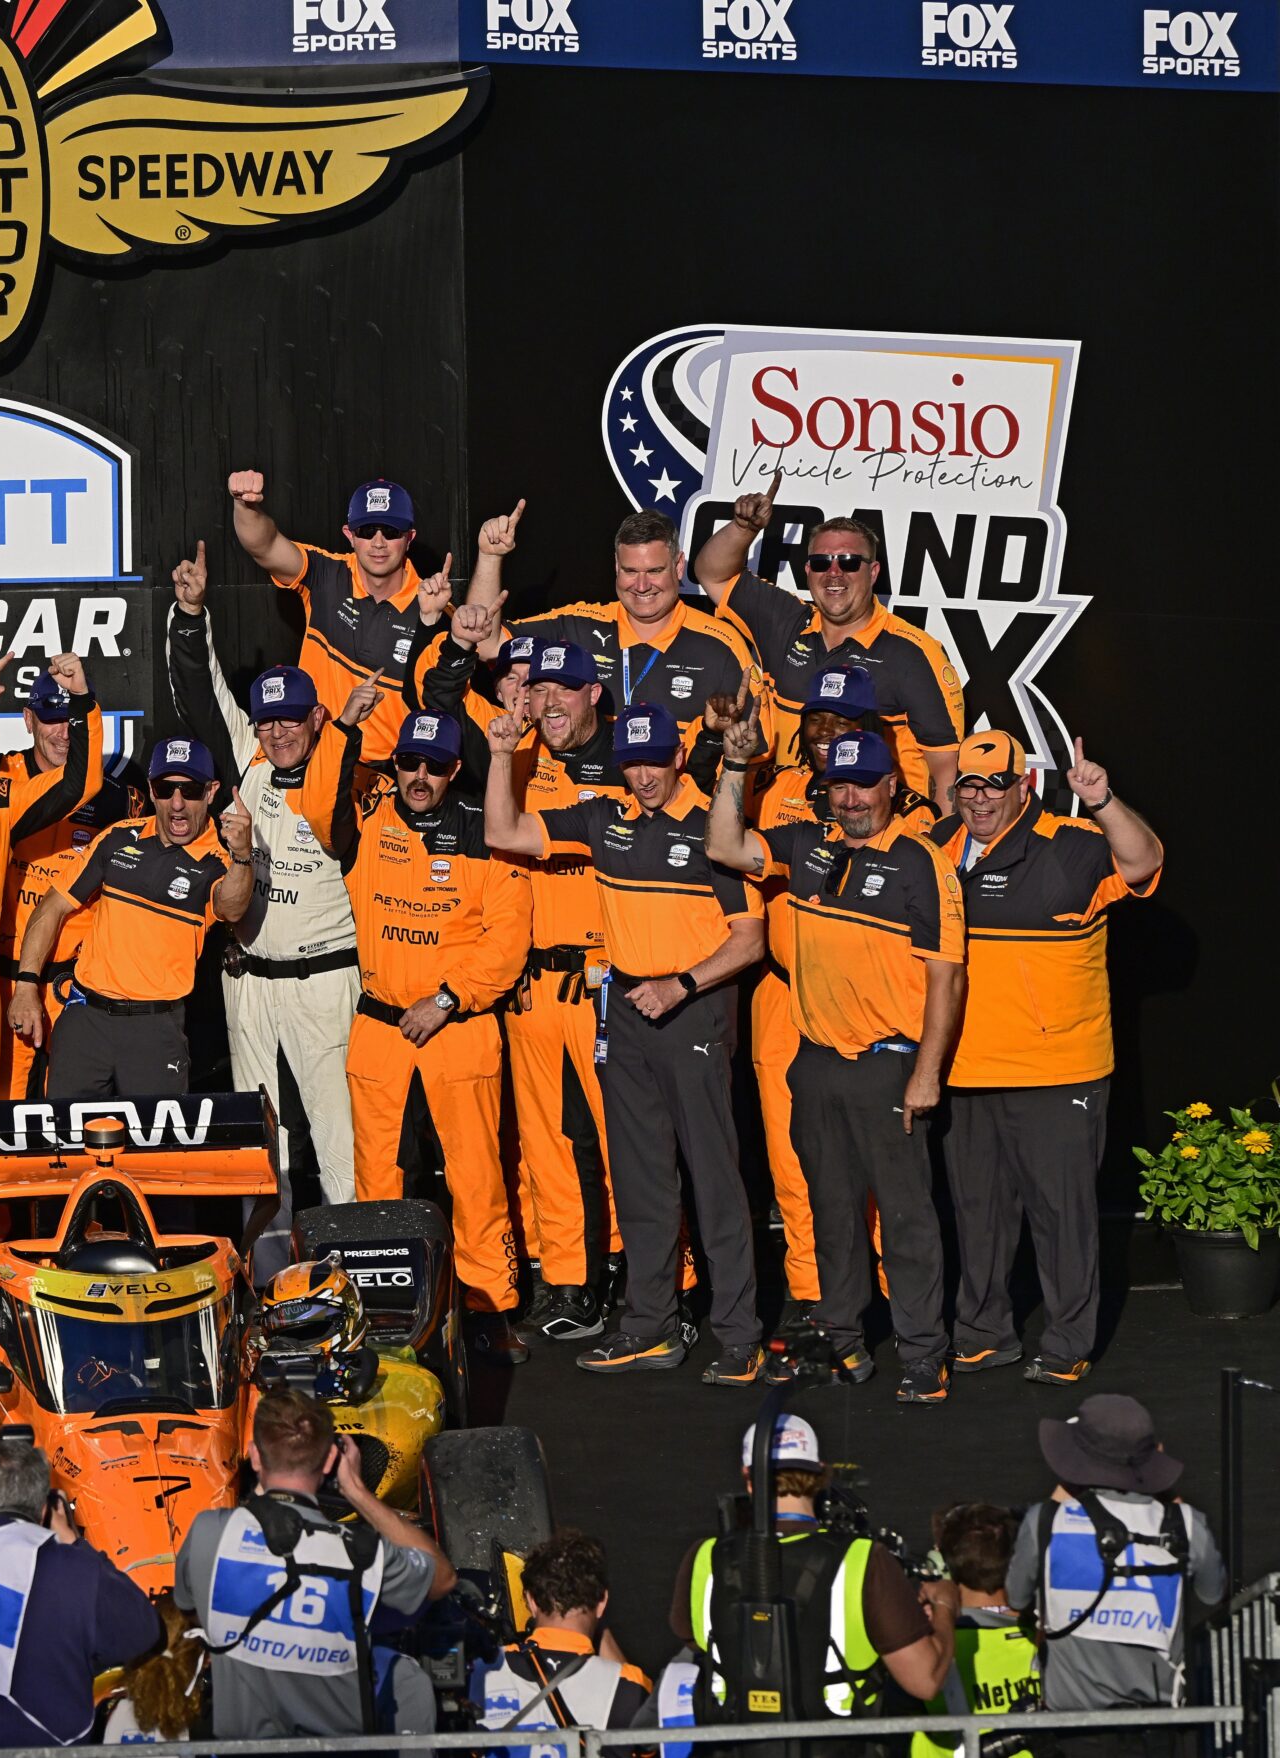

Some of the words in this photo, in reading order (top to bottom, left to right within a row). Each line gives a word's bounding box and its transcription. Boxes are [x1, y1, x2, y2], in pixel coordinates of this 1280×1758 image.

[294, 0, 394, 34] FOX
[487, 0, 577, 34] FOX
[703, 0, 795, 42] FOX
[923, 2, 1015, 49] FOX
[293, 33, 396, 52] SPORTS
[487, 33, 579, 52] SPORTS
[1144, 10, 1238, 57] FOX
[703, 41, 796, 60] SPORTS
[922, 49, 1017, 68] SPORTS
[1143, 57, 1240, 76] SPORTS
[78, 150, 333, 201] SPEEDWAY
[751, 365, 1019, 458] Sonsio
[732, 446, 852, 488] Vehicle
[862, 451, 1033, 491] Protection
[416, 724, 433, 732] PRIX
[630, 727, 646, 735] PRIX
[380, 840, 409, 853] ARROW
[374, 893, 454, 913] REYNOLDS
[382, 925, 439, 945] ARROW
[344, 1248, 409, 1257] PRIZEPICKS
[108, 1282, 172, 1296] VELO
[133, 1475, 191, 1509] 7
[266, 1571, 330, 1625] 16
